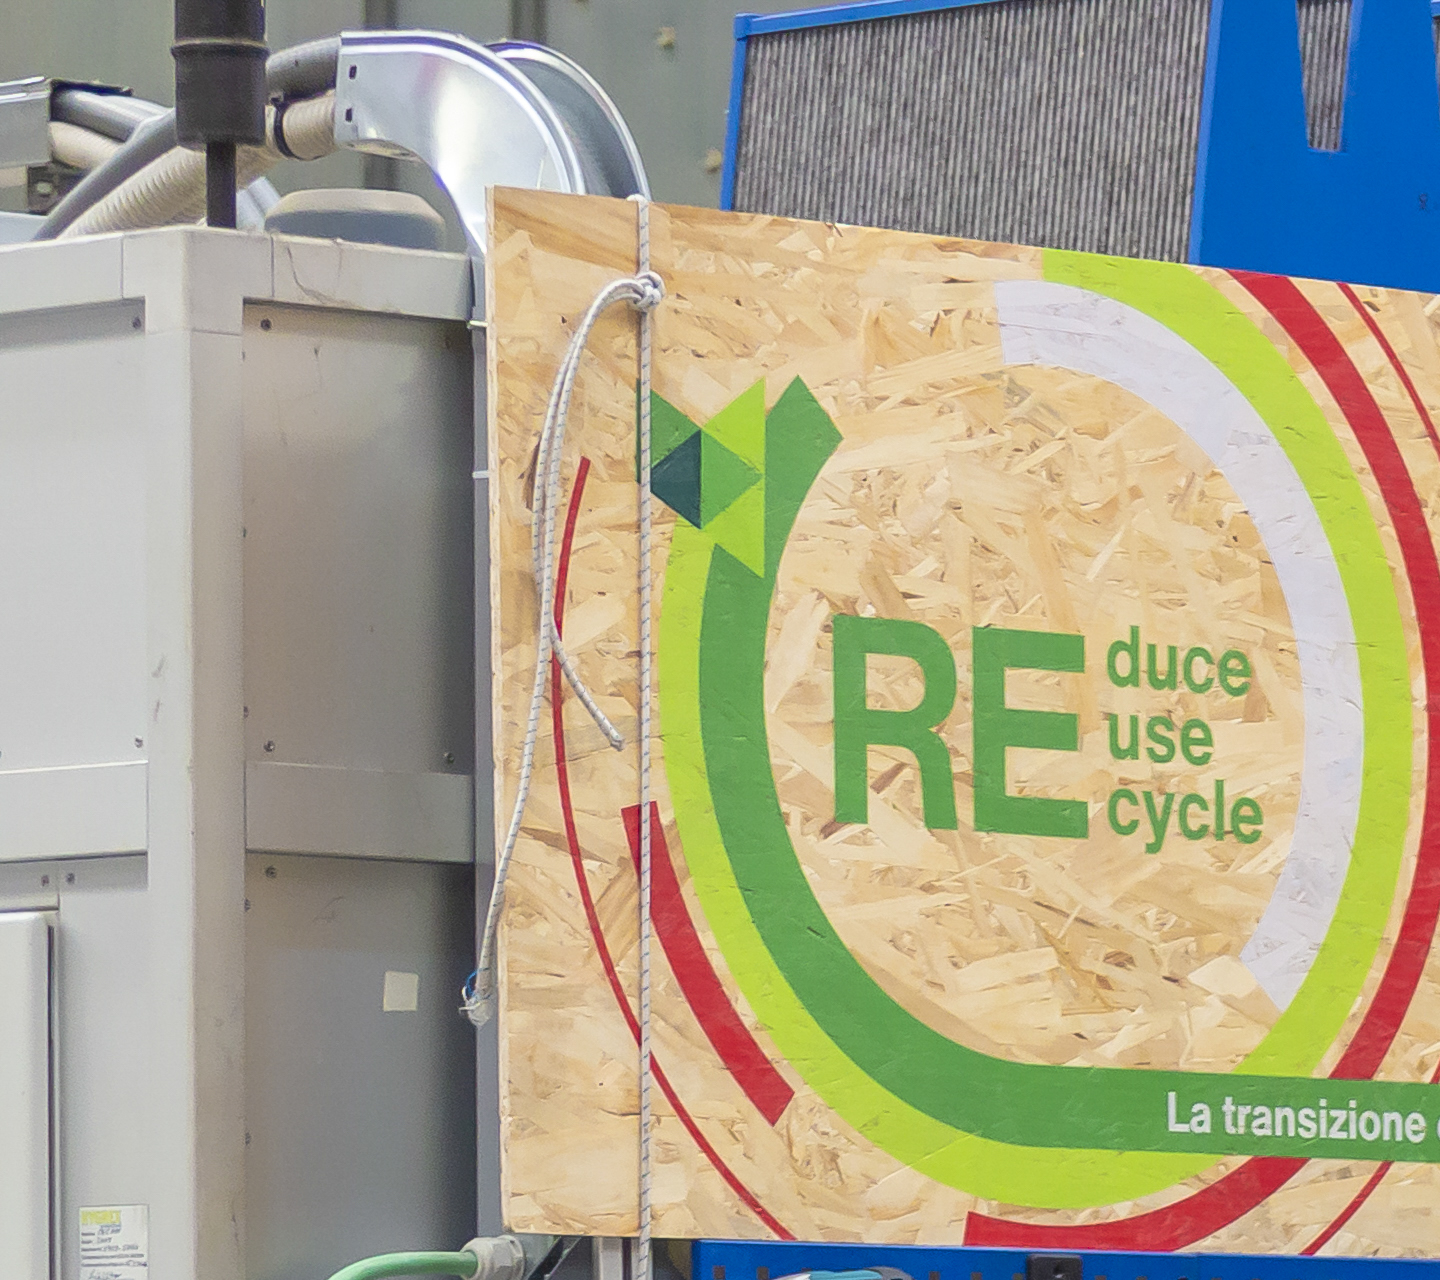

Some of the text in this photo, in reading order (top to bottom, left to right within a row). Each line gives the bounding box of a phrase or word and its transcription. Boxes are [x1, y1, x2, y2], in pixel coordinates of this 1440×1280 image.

[1107, 625, 1252, 697] duce
[831, 615, 1089, 839] RE
[1108, 713, 1214, 766] use
[1107, 778, 1264, 855] cycle
[1166, 1091, 1212, 1135] La
[1222, 1095, 1426, 1144] transizione
